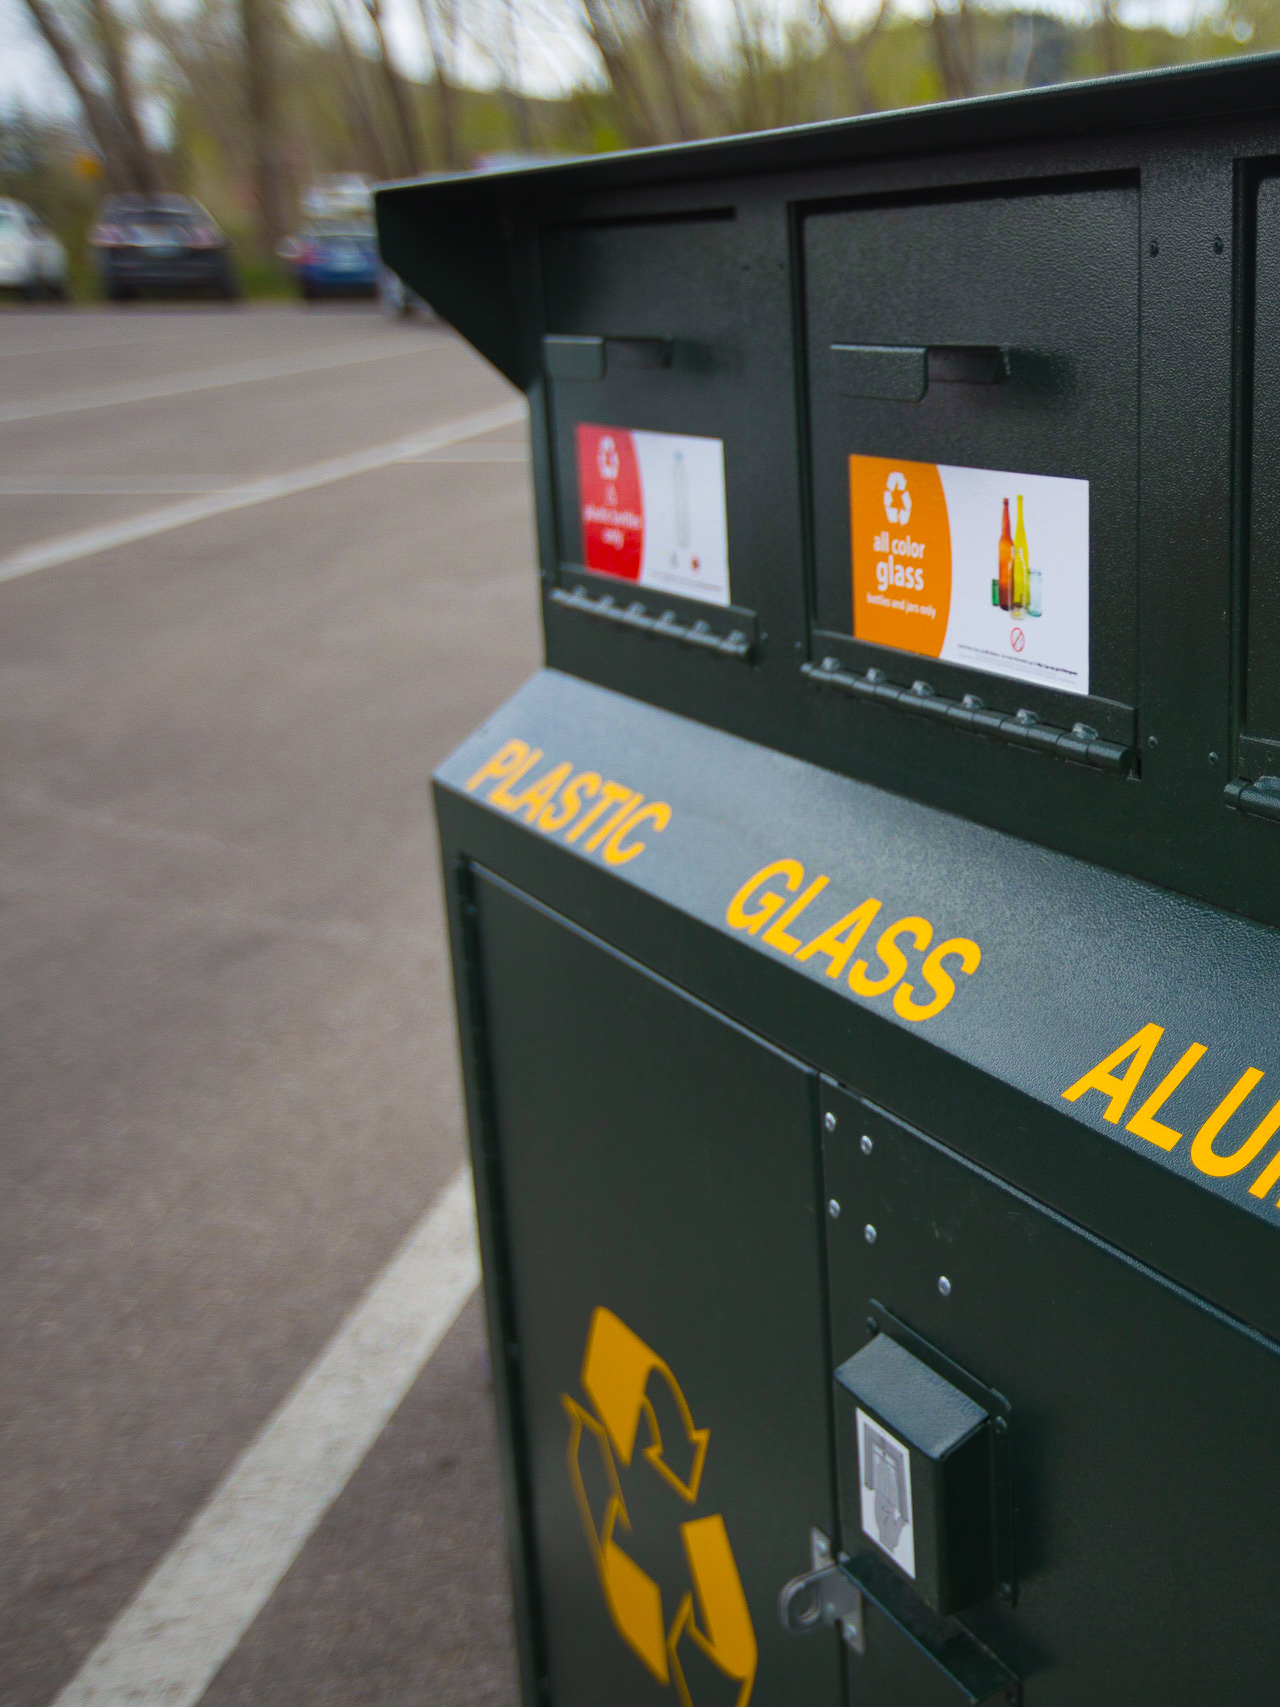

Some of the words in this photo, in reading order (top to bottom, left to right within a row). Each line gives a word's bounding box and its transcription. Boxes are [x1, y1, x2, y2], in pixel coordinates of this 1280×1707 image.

[873, 532, 889, 553] all
[891, 535, 926, 559] color
[876, 555, 924, 592] glass
[866, 592, 891, 608] bottles
[892, 598, 905, 611] and
[920, 604, 937, 620] only
[467, 740, 672, 866] PLASTIC
[725, 858, 982, 1023] GLASS
